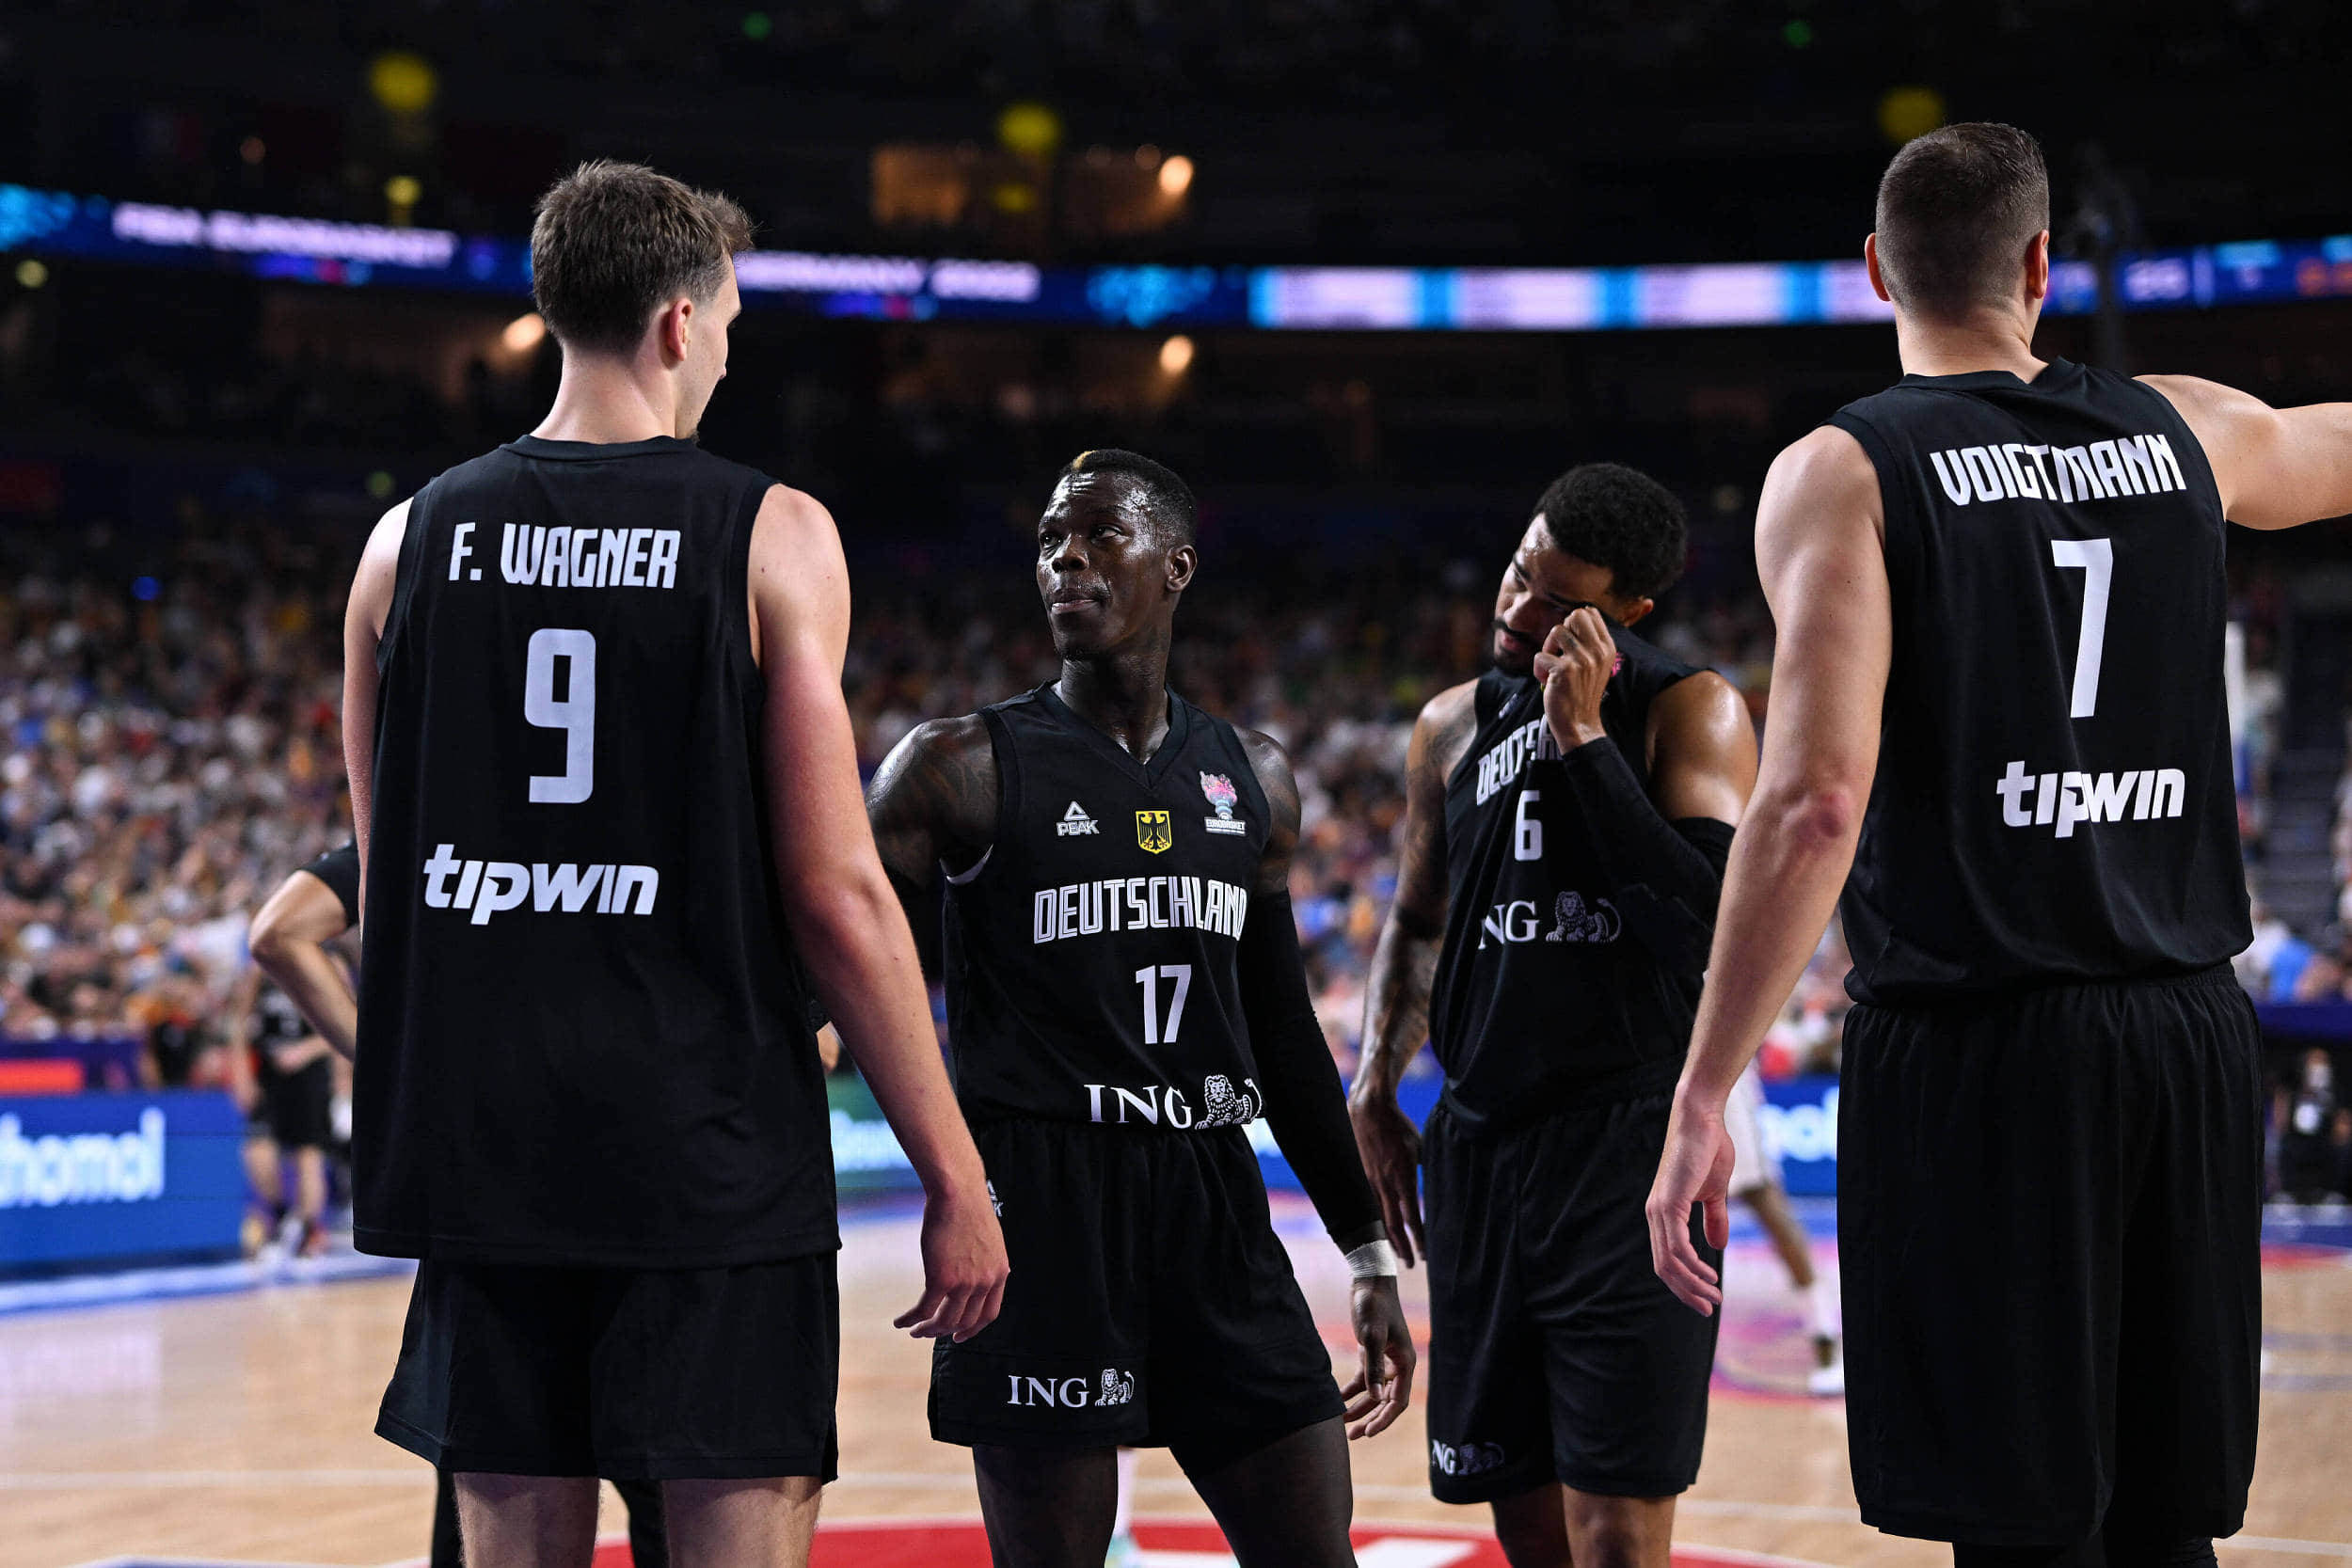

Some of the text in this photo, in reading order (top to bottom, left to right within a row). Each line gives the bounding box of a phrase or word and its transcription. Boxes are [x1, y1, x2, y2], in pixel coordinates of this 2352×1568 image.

[1929, 434, 2187, 507] VOIGTMANN
[448, 522, 681, 590] F. WAGNER
[2050, 537, 2114, 719] 7
[524, 627, 596, 804] 9
[1056, 819, 1100, 836] PEAK
[1514, 789, 1543, 862] 6
[1995, 760, 2185, 838] tipwin
[423, 843, 660, 926] tipwin
[1033, 876, 1249, 944] DEUTSCHLAND
[1477, 899, 1540, 950] NG
[1135, 963, 1192, 1045] 17
[1083, 1084, 1193, 1130] ING
[1007, 1374, 1089, 1408] ING
[1431, 1438, 1457, 1476] NG
